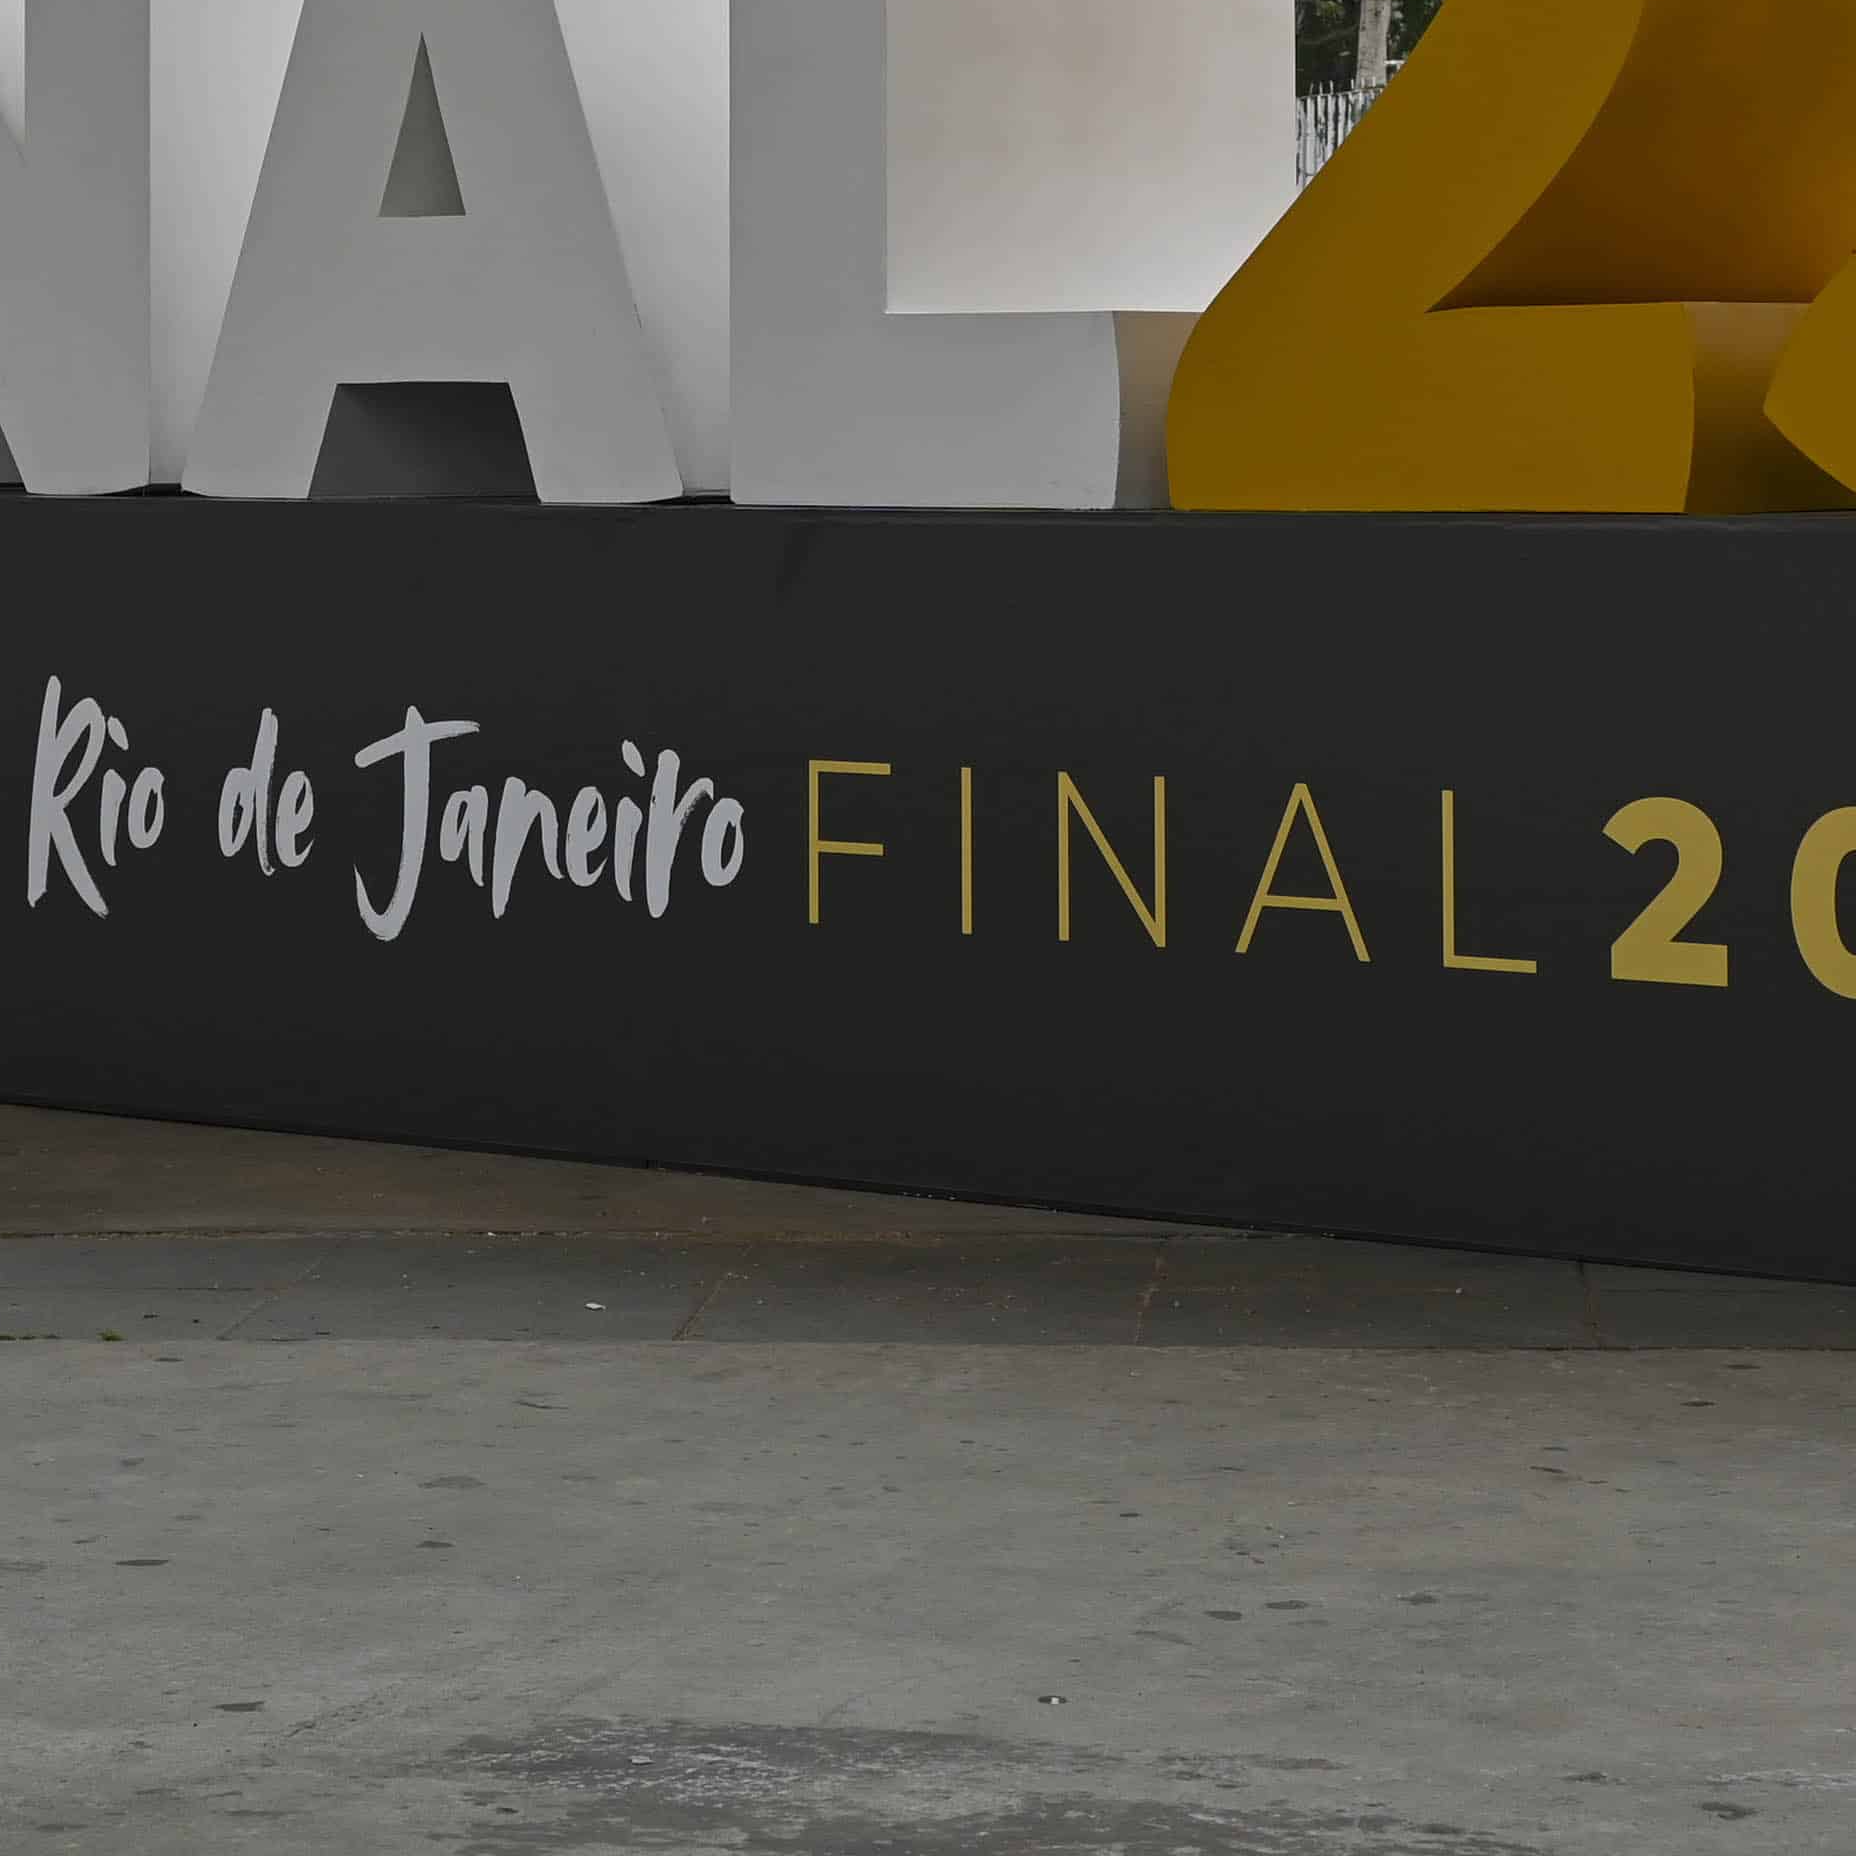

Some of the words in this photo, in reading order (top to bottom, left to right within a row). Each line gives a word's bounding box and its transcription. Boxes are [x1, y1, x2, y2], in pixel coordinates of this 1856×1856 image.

[27, 675, 165, 918] Rio
[218, 707, 315, 876] de
[354, 705, 745, 942] Janeiro
[808, 759, 1537, 974] FINAL
